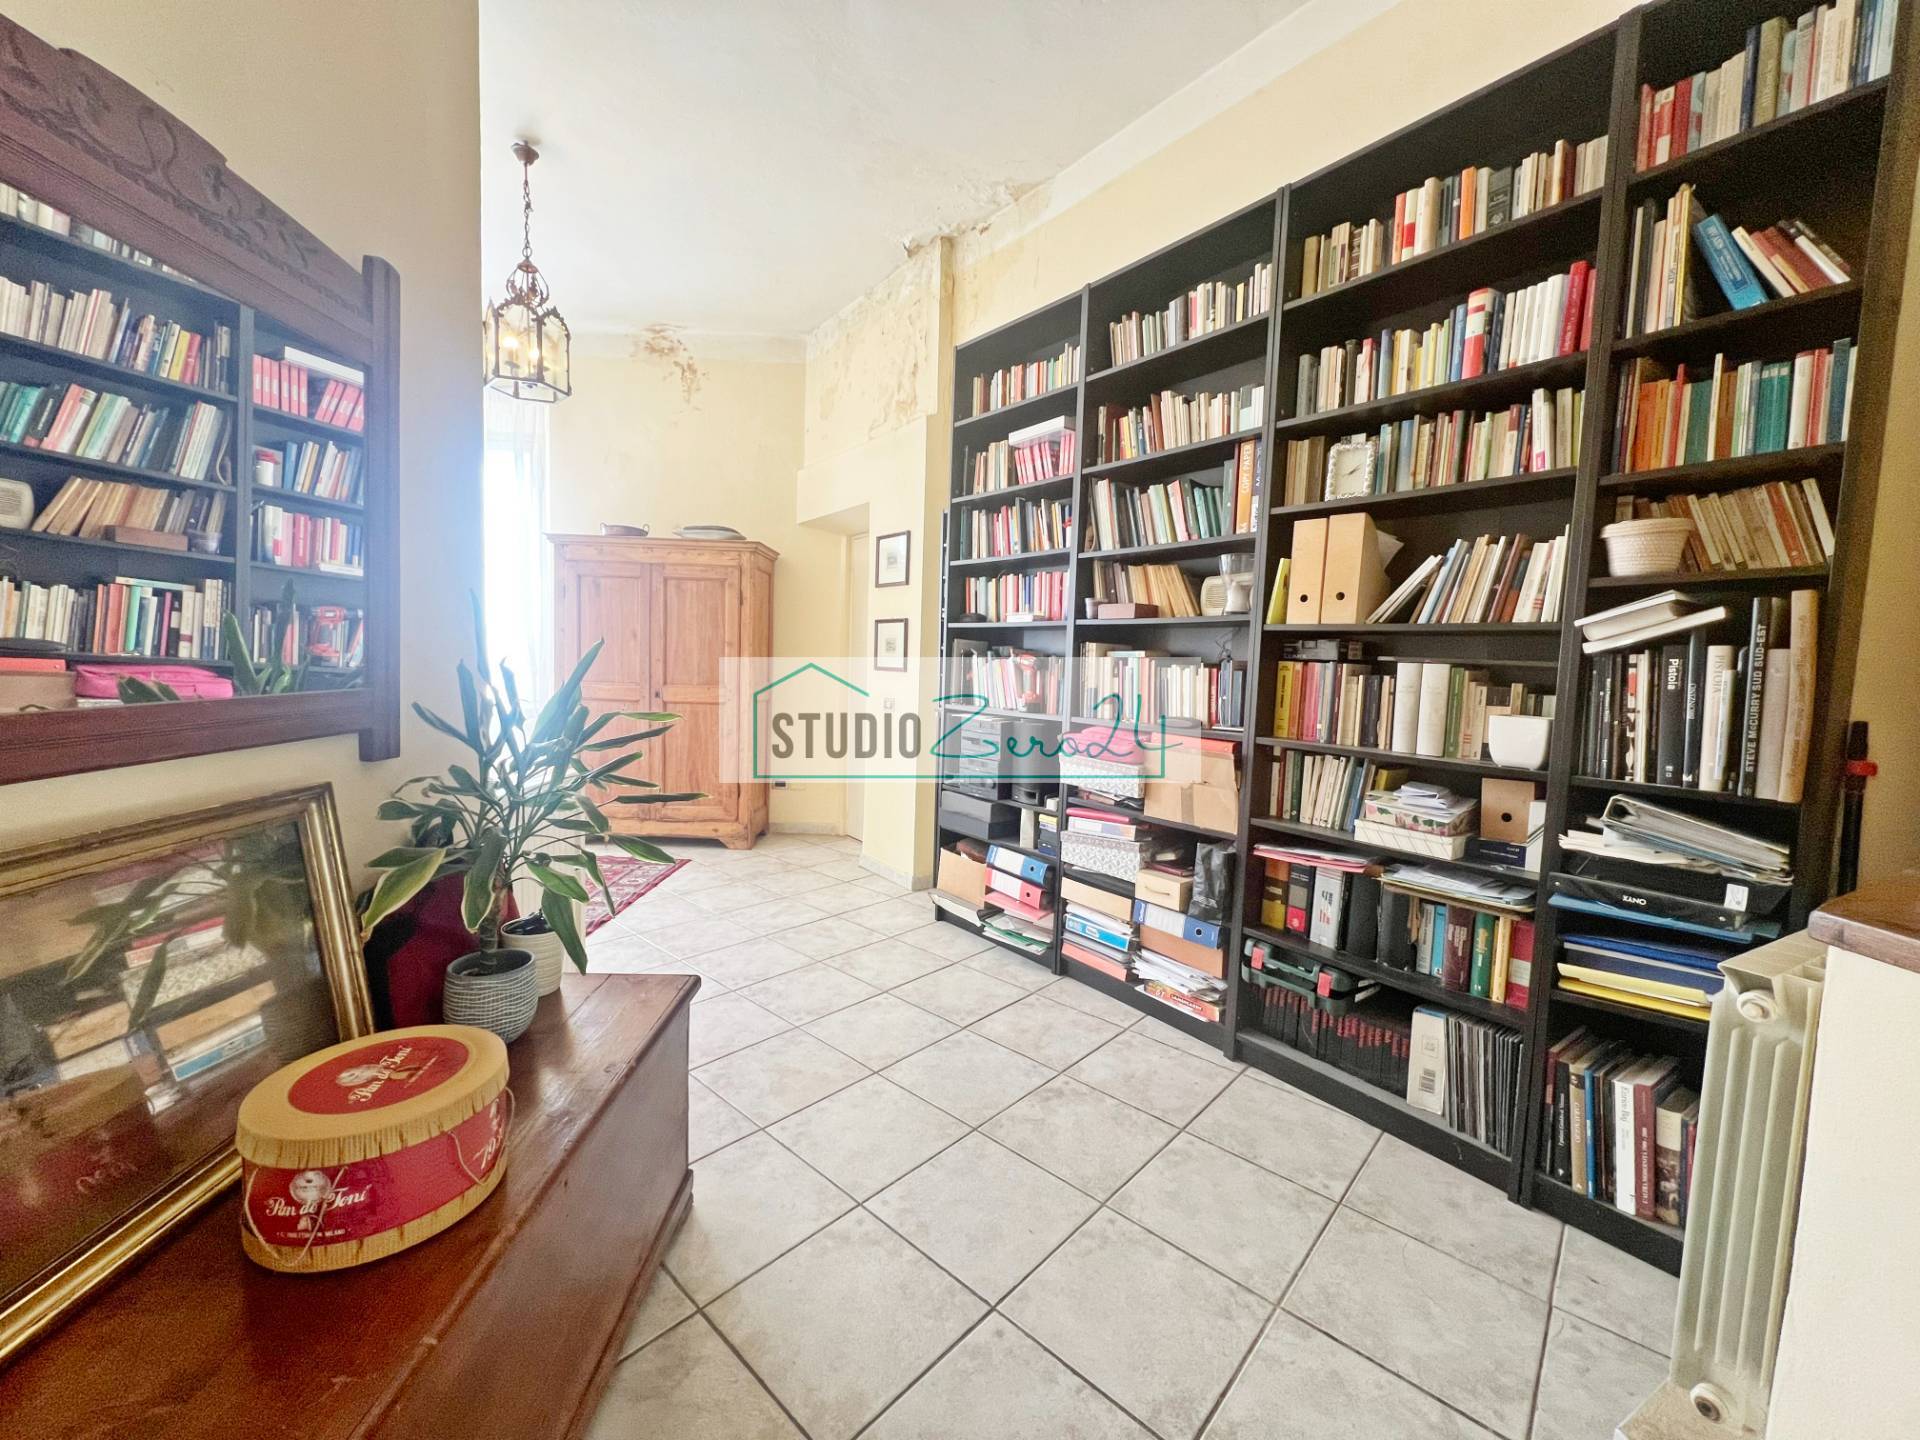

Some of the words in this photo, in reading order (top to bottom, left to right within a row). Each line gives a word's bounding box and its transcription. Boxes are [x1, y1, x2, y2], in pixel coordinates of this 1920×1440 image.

[1753, 624, 1767, 667] SUD-EST
[1751, 670, 1763, 691] SUD
[1747, 693, 1760, 739] McCURRY
[1745, 741, 1757, 772] STEVE
[265, 1197, 297, 1216] Pan
[325, 1183, 373, 1211] Toni
